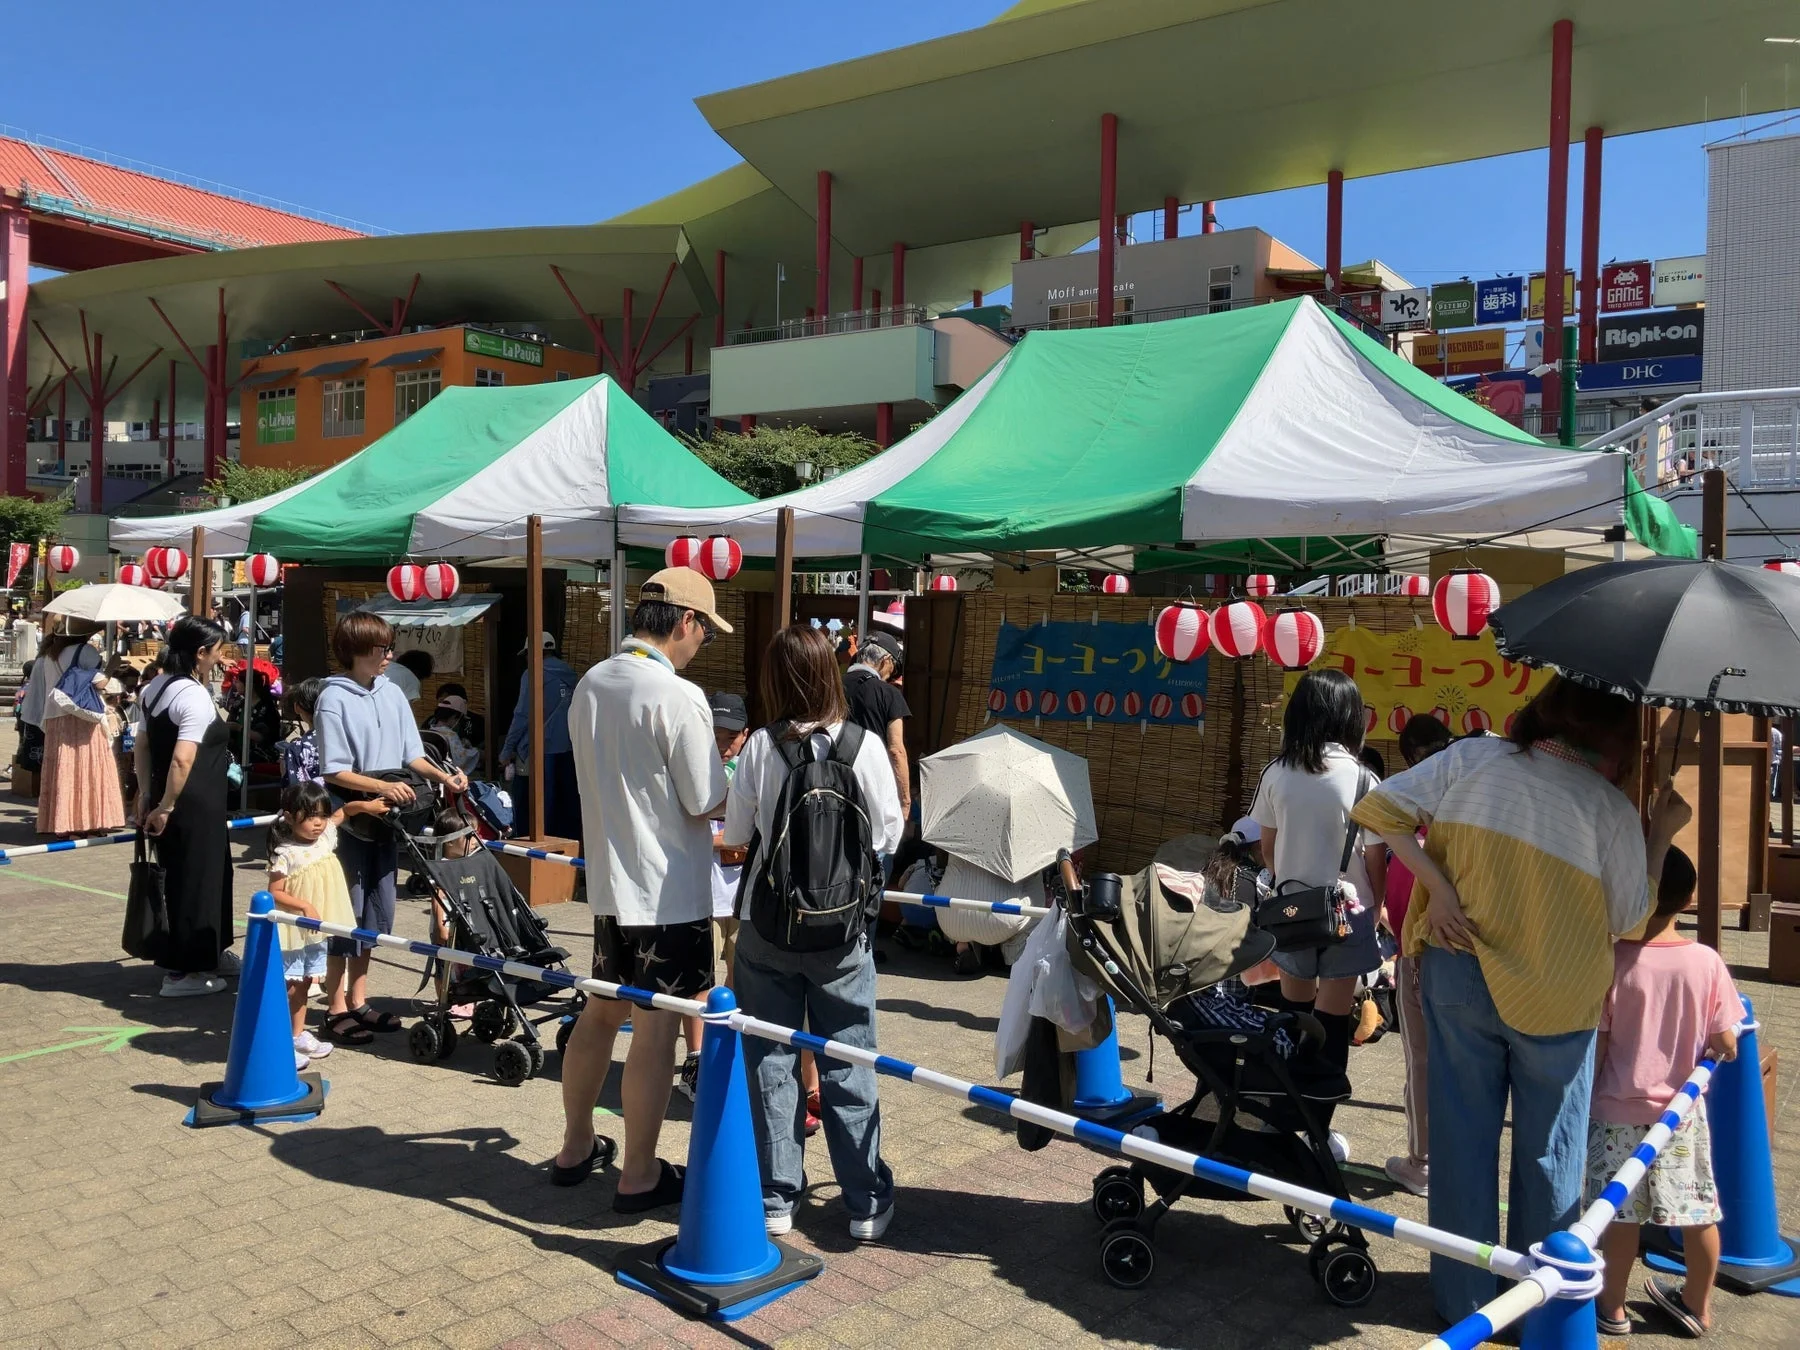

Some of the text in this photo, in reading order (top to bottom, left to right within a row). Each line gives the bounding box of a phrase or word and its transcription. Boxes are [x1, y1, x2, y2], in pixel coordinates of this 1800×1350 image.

[1658, 275, 1669, 283] BE
[1671, 273, 1703, 282] studio
[1047, 282, 1135, 300] Moff anim cafe
[1607, 286, 1644, 303] GAME
[1483, 291, 1516, 310] 歯科
[1605, 324, 1697, 348] Right-on
[1417, 343, 1446, 357] TOWE
[1447, 340, 1484, 354] RECORDS
[1622, 364, 1663, 380] DHC
[1022, 642, 1172, 679] ヨーヨーつり
